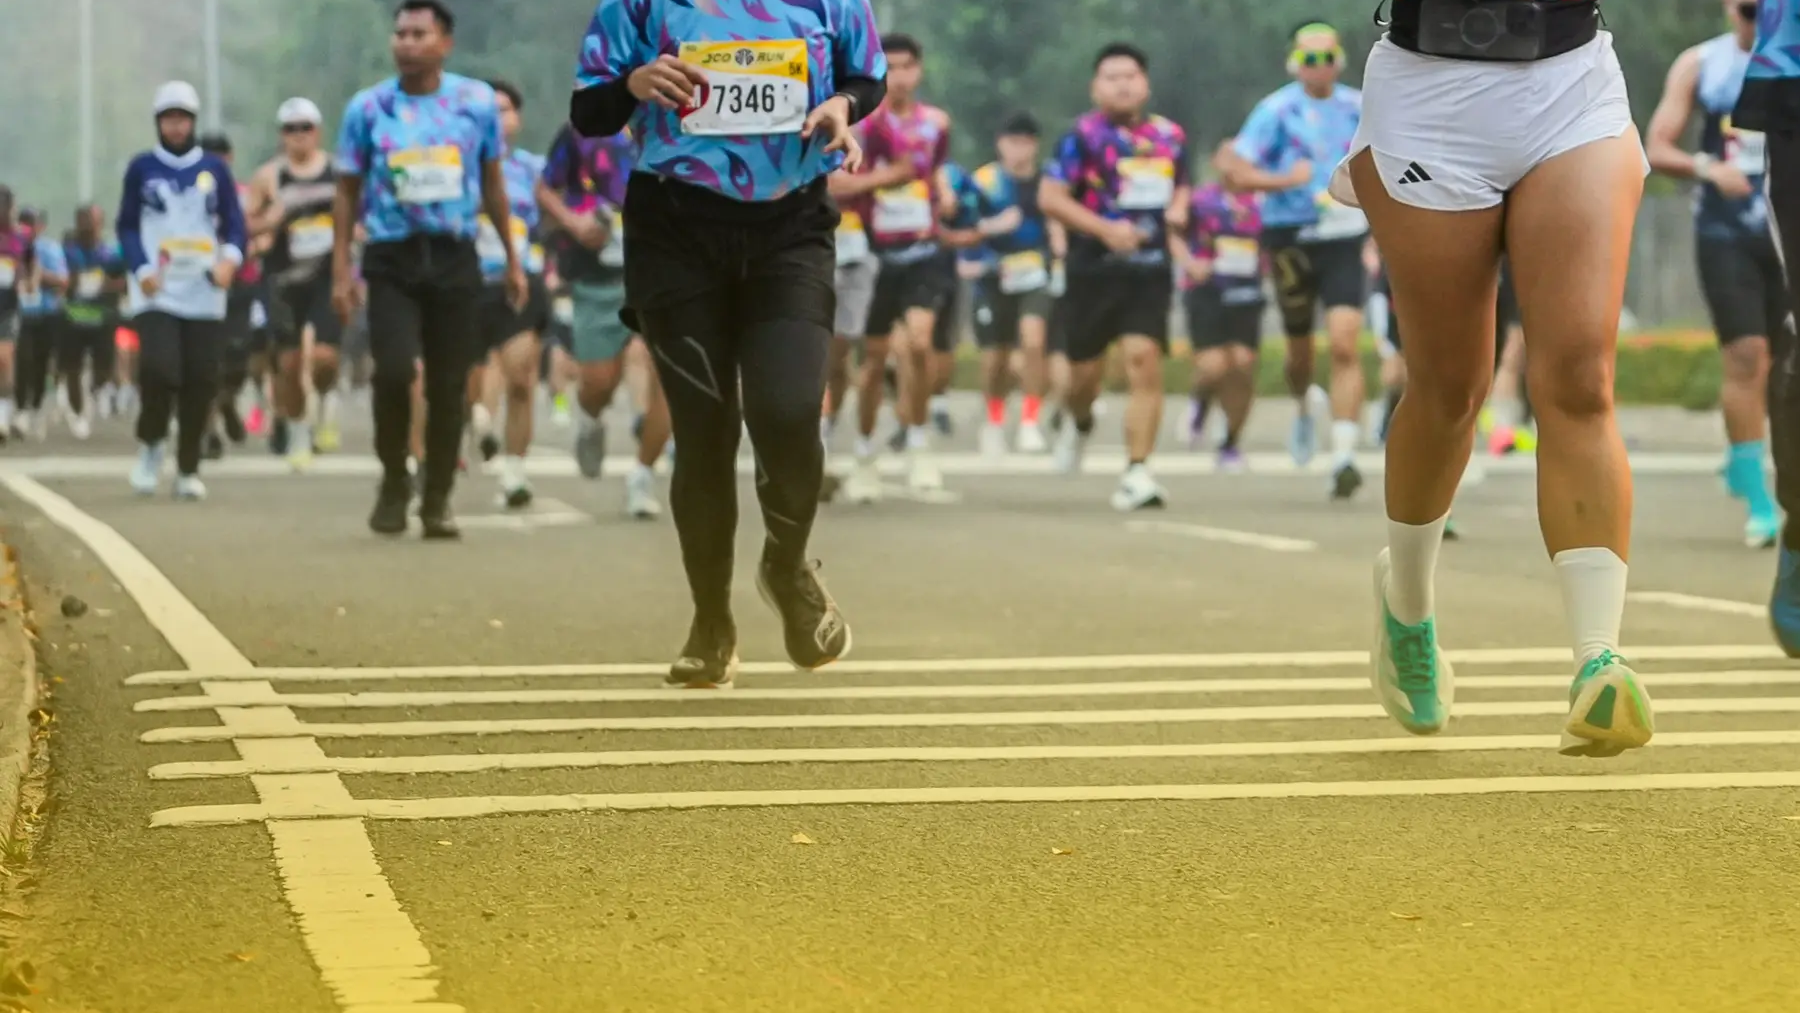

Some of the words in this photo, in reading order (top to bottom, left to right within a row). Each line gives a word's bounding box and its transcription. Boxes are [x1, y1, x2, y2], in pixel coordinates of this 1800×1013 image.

[701, 52, 732, 65] JCO
[756, 51, 785, 63] RUN
[712, 83, 776, 115] 7346
